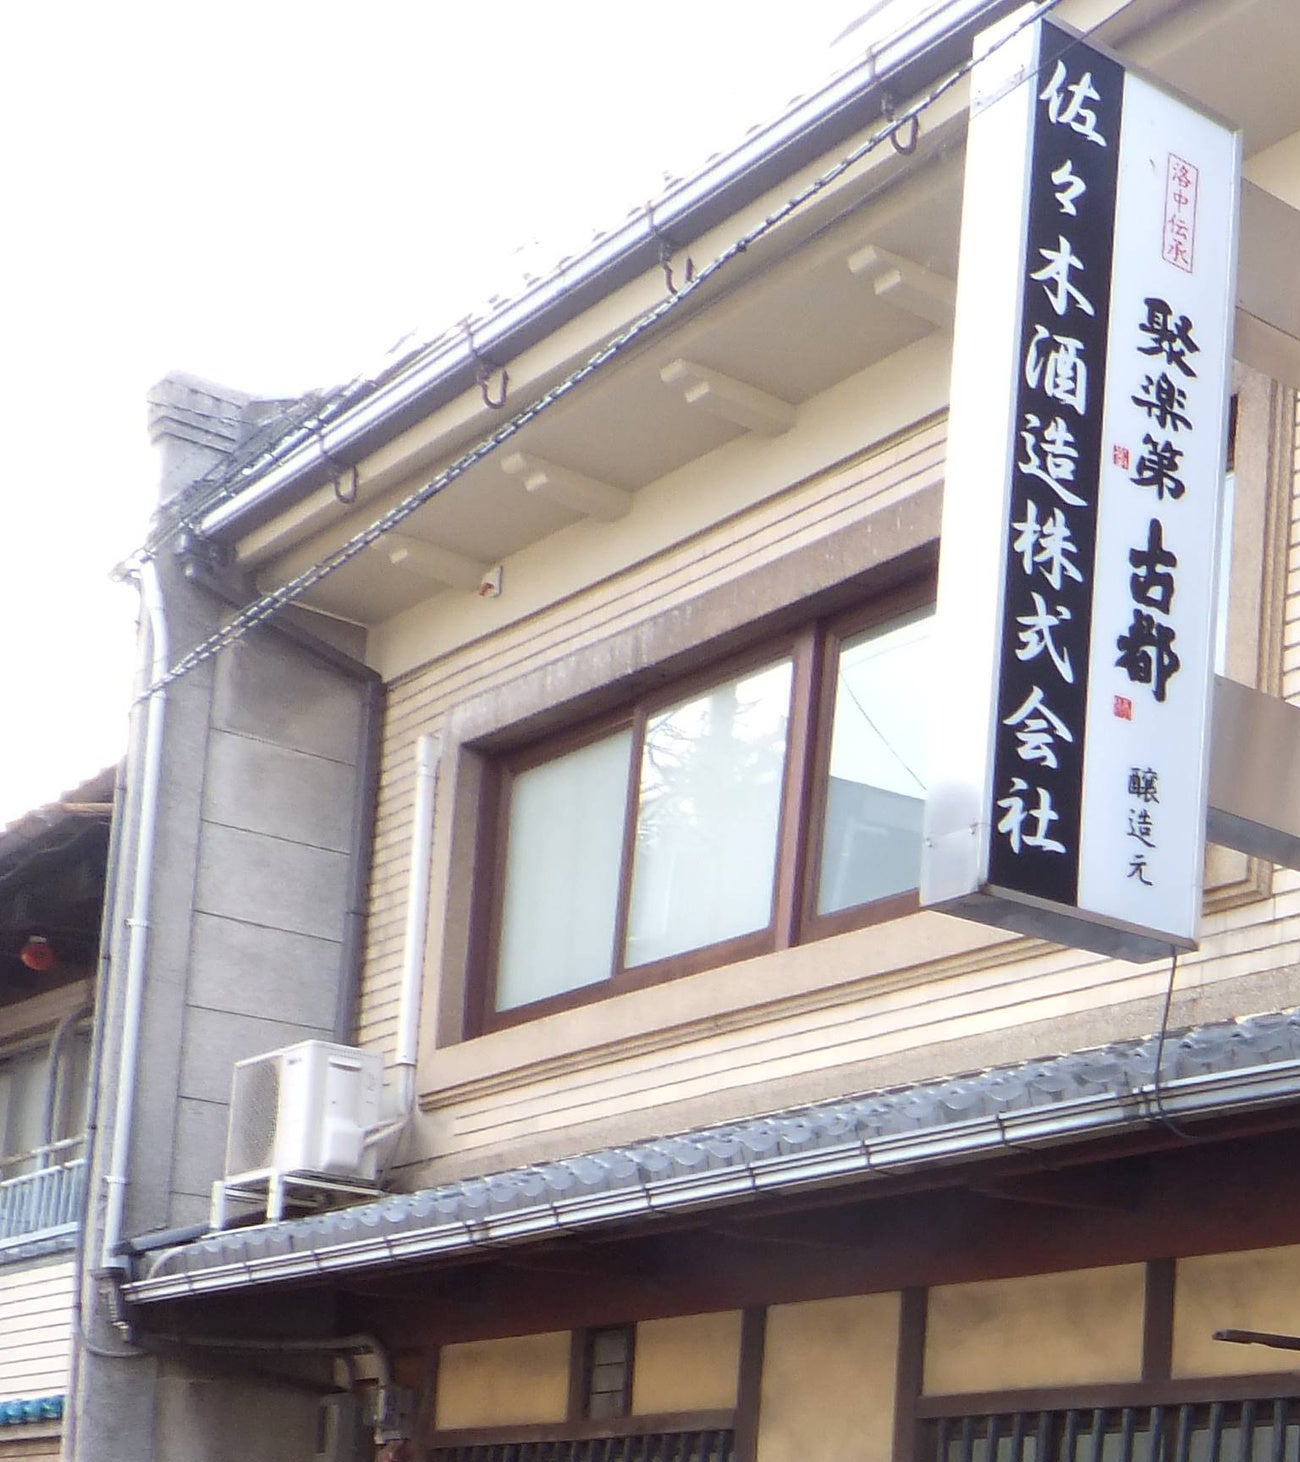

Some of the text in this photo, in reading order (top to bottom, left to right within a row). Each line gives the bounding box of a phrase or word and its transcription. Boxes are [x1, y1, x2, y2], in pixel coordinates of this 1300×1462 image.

[1166, 163, 1192, 265] 洛中伝承
[996, 59, 1107, 855] 佐々木酒造株式会社
[1114, 298, 1201, 702] 聚楽第 古都
[1126, 767, 1160, 887] 醸造元
